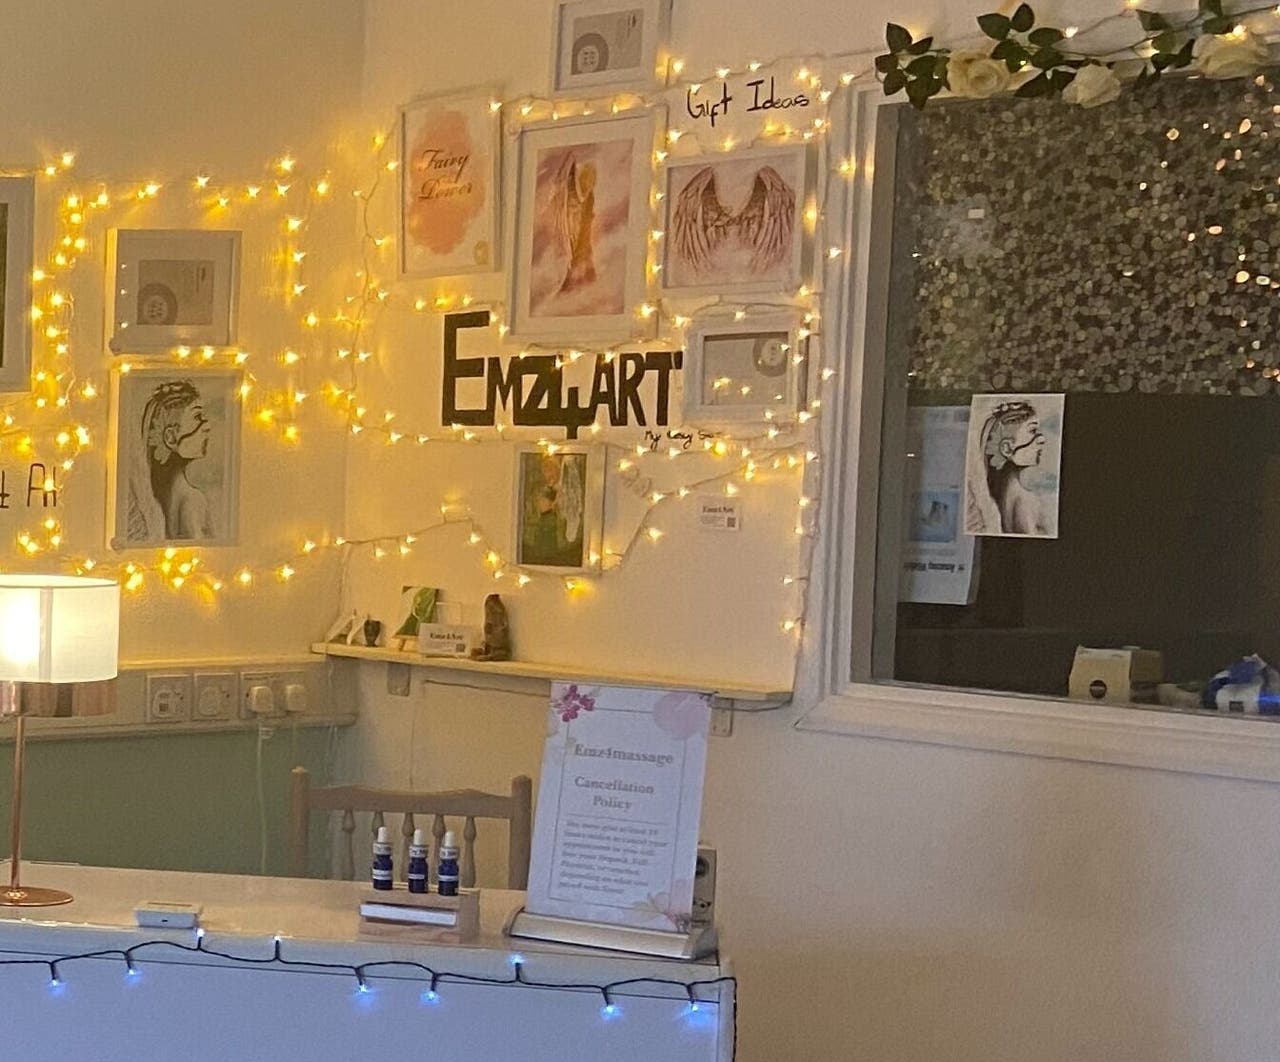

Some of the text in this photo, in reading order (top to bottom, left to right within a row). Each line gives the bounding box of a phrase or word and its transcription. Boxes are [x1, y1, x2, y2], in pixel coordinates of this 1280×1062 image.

[687, 75, 810, 128] Gift Ideas
[418, 148, 470, 184] Fairy
[574, 743, 674, 768] Emz4massage
[574, 775, 655, 795] Cancellation
[592, 795, 633, 813] Policy
